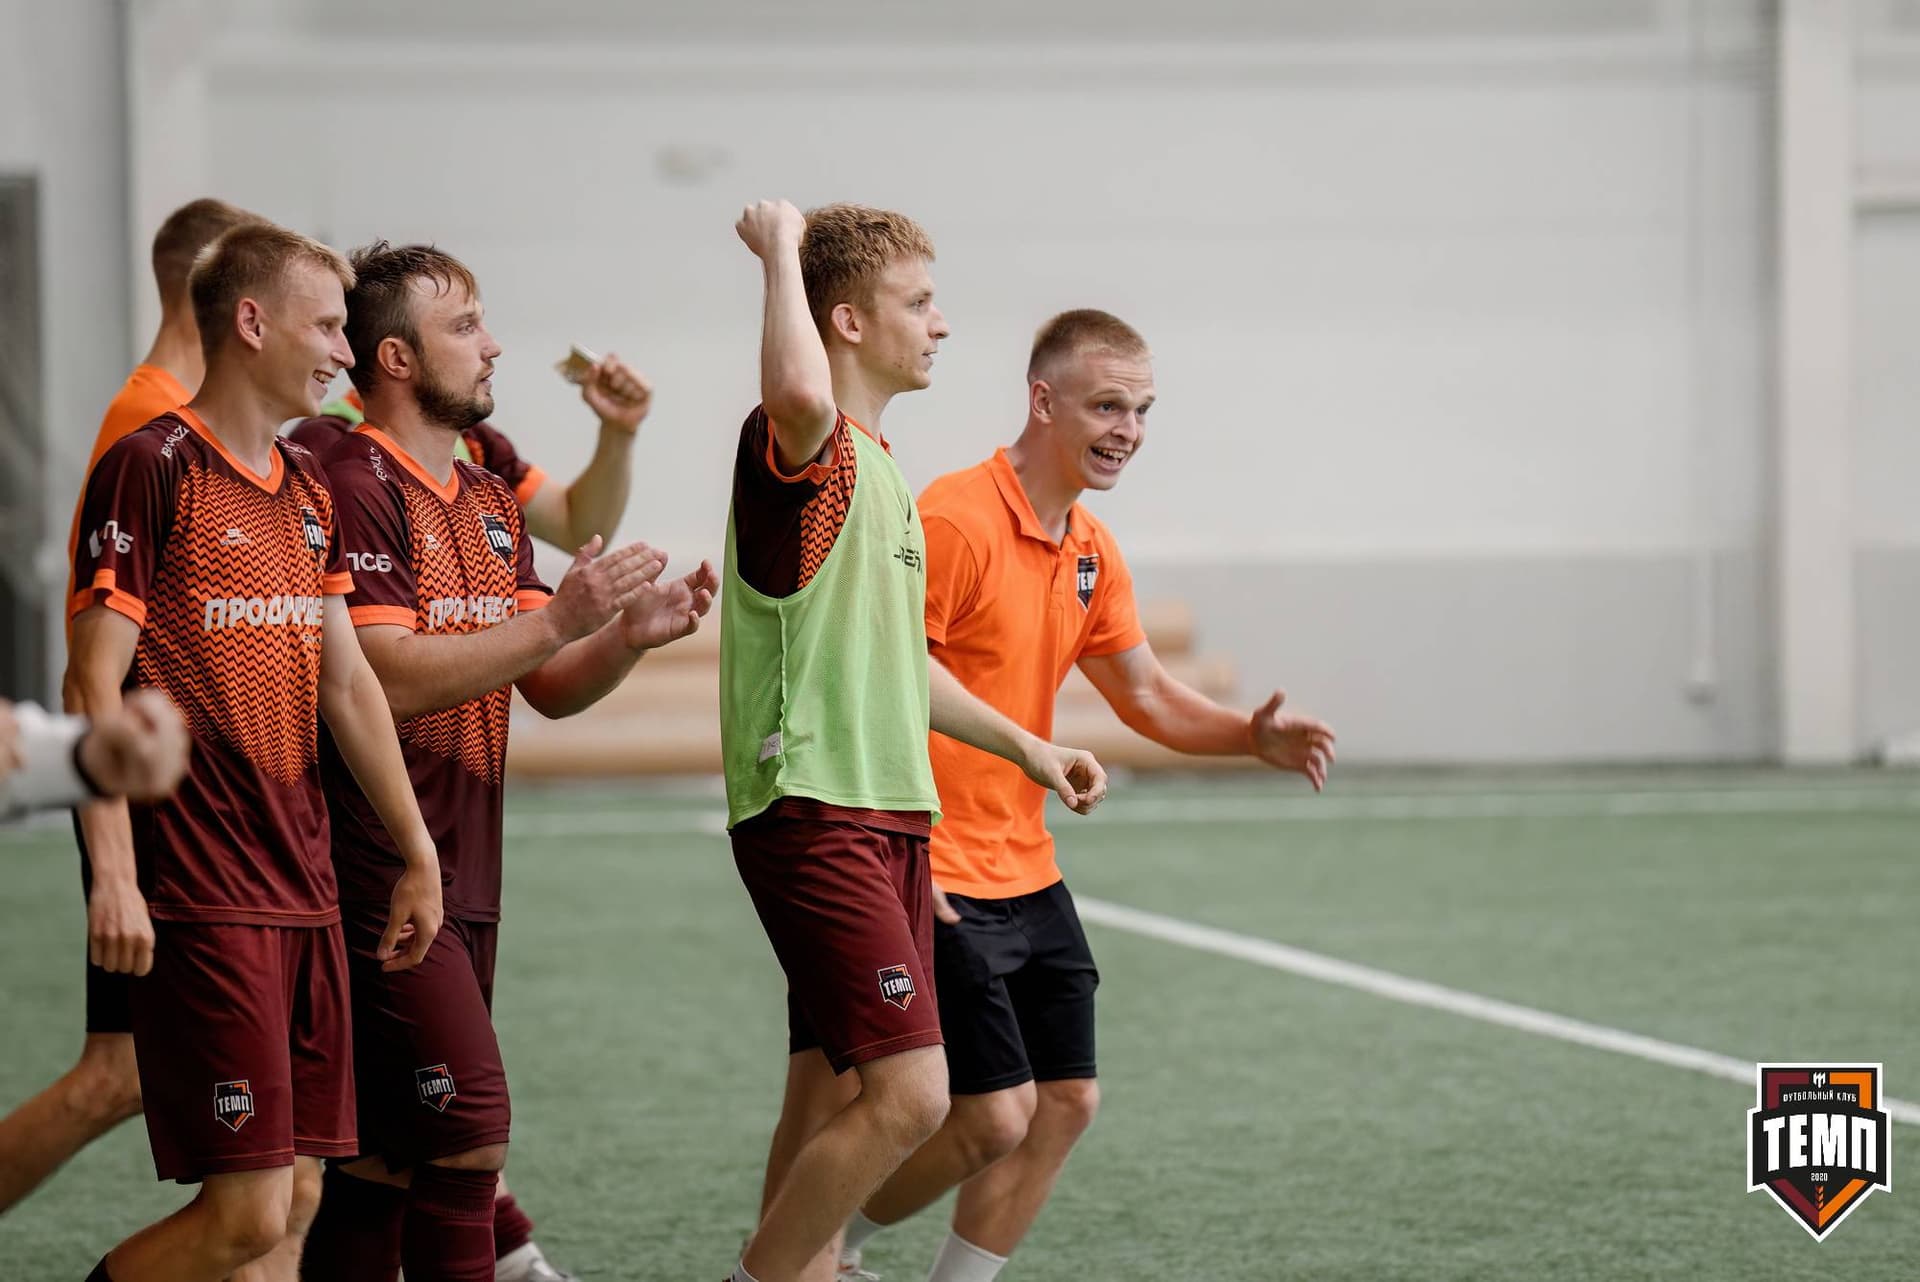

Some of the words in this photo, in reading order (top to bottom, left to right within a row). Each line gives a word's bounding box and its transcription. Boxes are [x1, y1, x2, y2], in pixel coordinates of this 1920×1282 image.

[883, 977, 912, 997] ТЕМП
[420, 1078, 452, 1097] ТЕМП
[217, 1095, 250, 1114] ТЕМП
